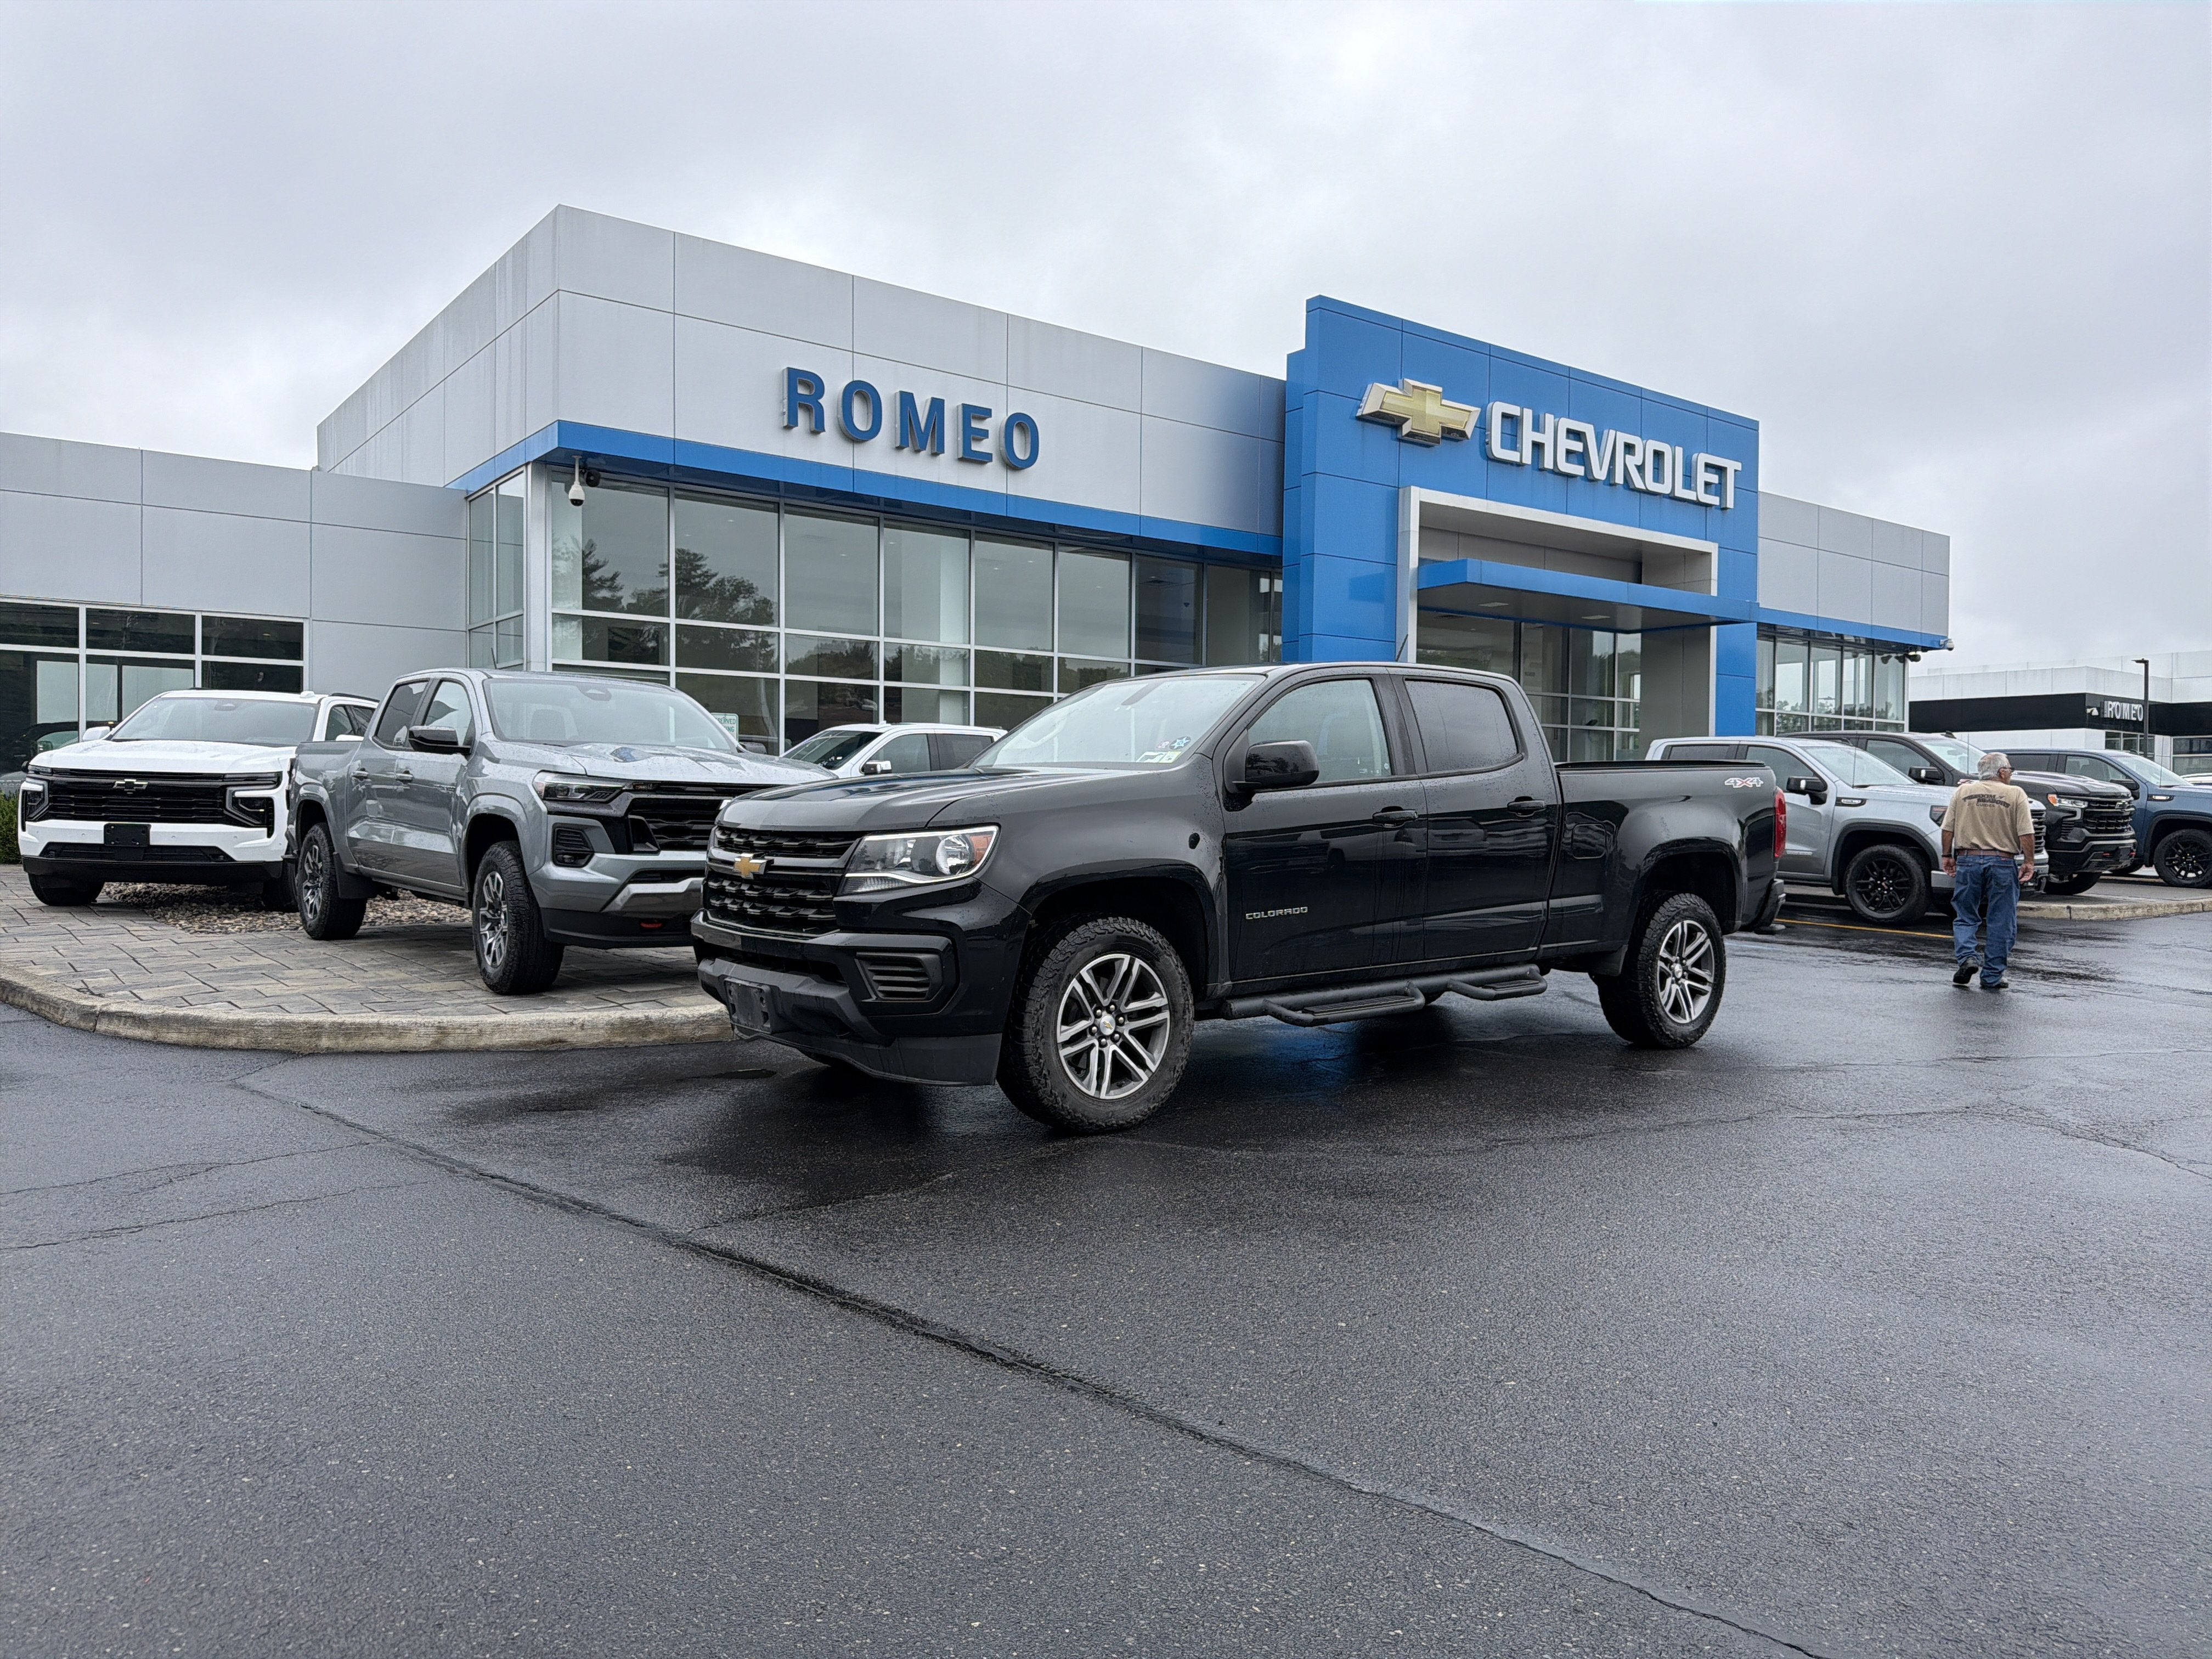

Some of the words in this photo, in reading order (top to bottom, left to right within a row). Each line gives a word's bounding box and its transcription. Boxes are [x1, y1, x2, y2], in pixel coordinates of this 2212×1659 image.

[783, 367, 1039, 470] ROMEO
[1486, 401, 1742, 509] CHEVROLET
[2104, 701, 2143, 721] ROMEO
[1245, 906, 1308, 919] COLORADO
